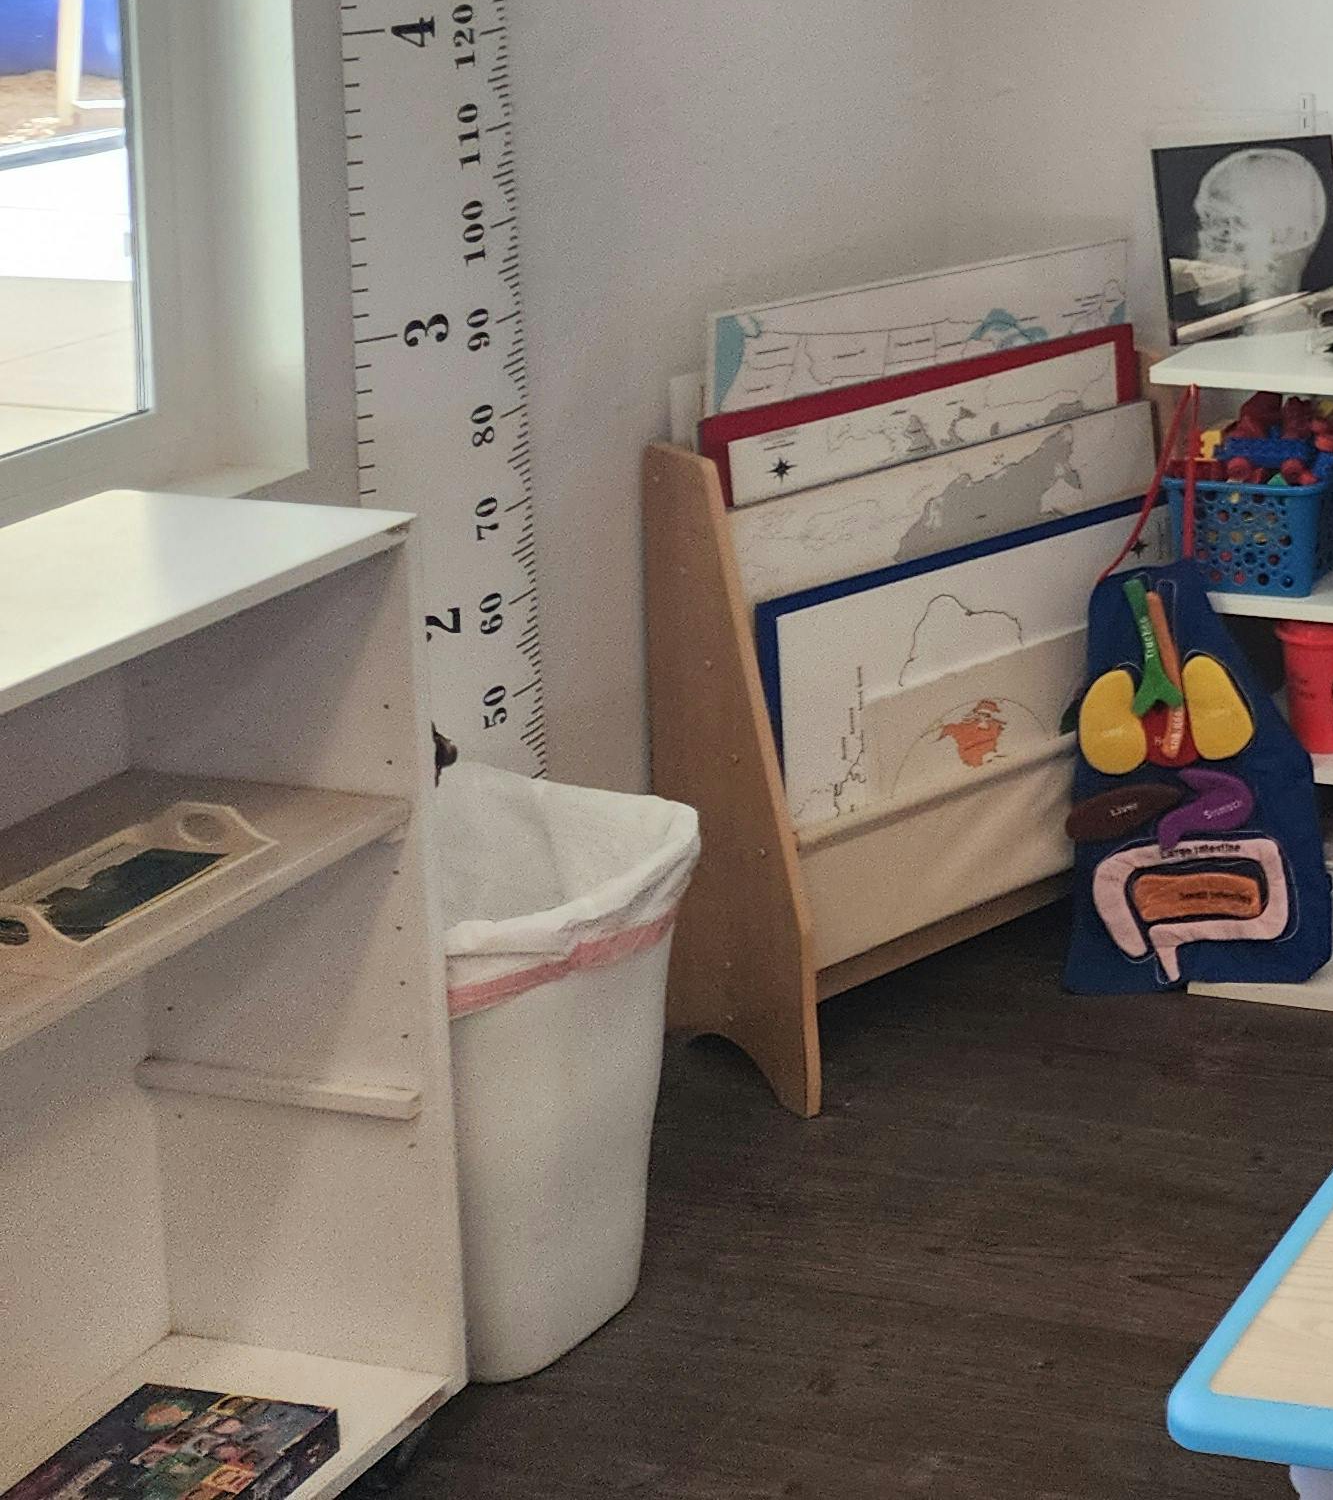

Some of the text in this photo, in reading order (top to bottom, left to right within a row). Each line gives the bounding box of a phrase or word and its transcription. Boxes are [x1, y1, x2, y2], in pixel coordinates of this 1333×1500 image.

[391, 16, 436, 48] 4
[453, 3, 476, 68] 120
[458, 102, 481, 167] 110
[463, 200, 487, 264] 100
[404, 313, 450, 347] 3
[468, 308, 490, 352] 90
[472, 404, 495, 449] 80
[476, 496, 500, 541] 70
[480, 592, 504, 635] 60
[484, 685, 508, 729] 50
